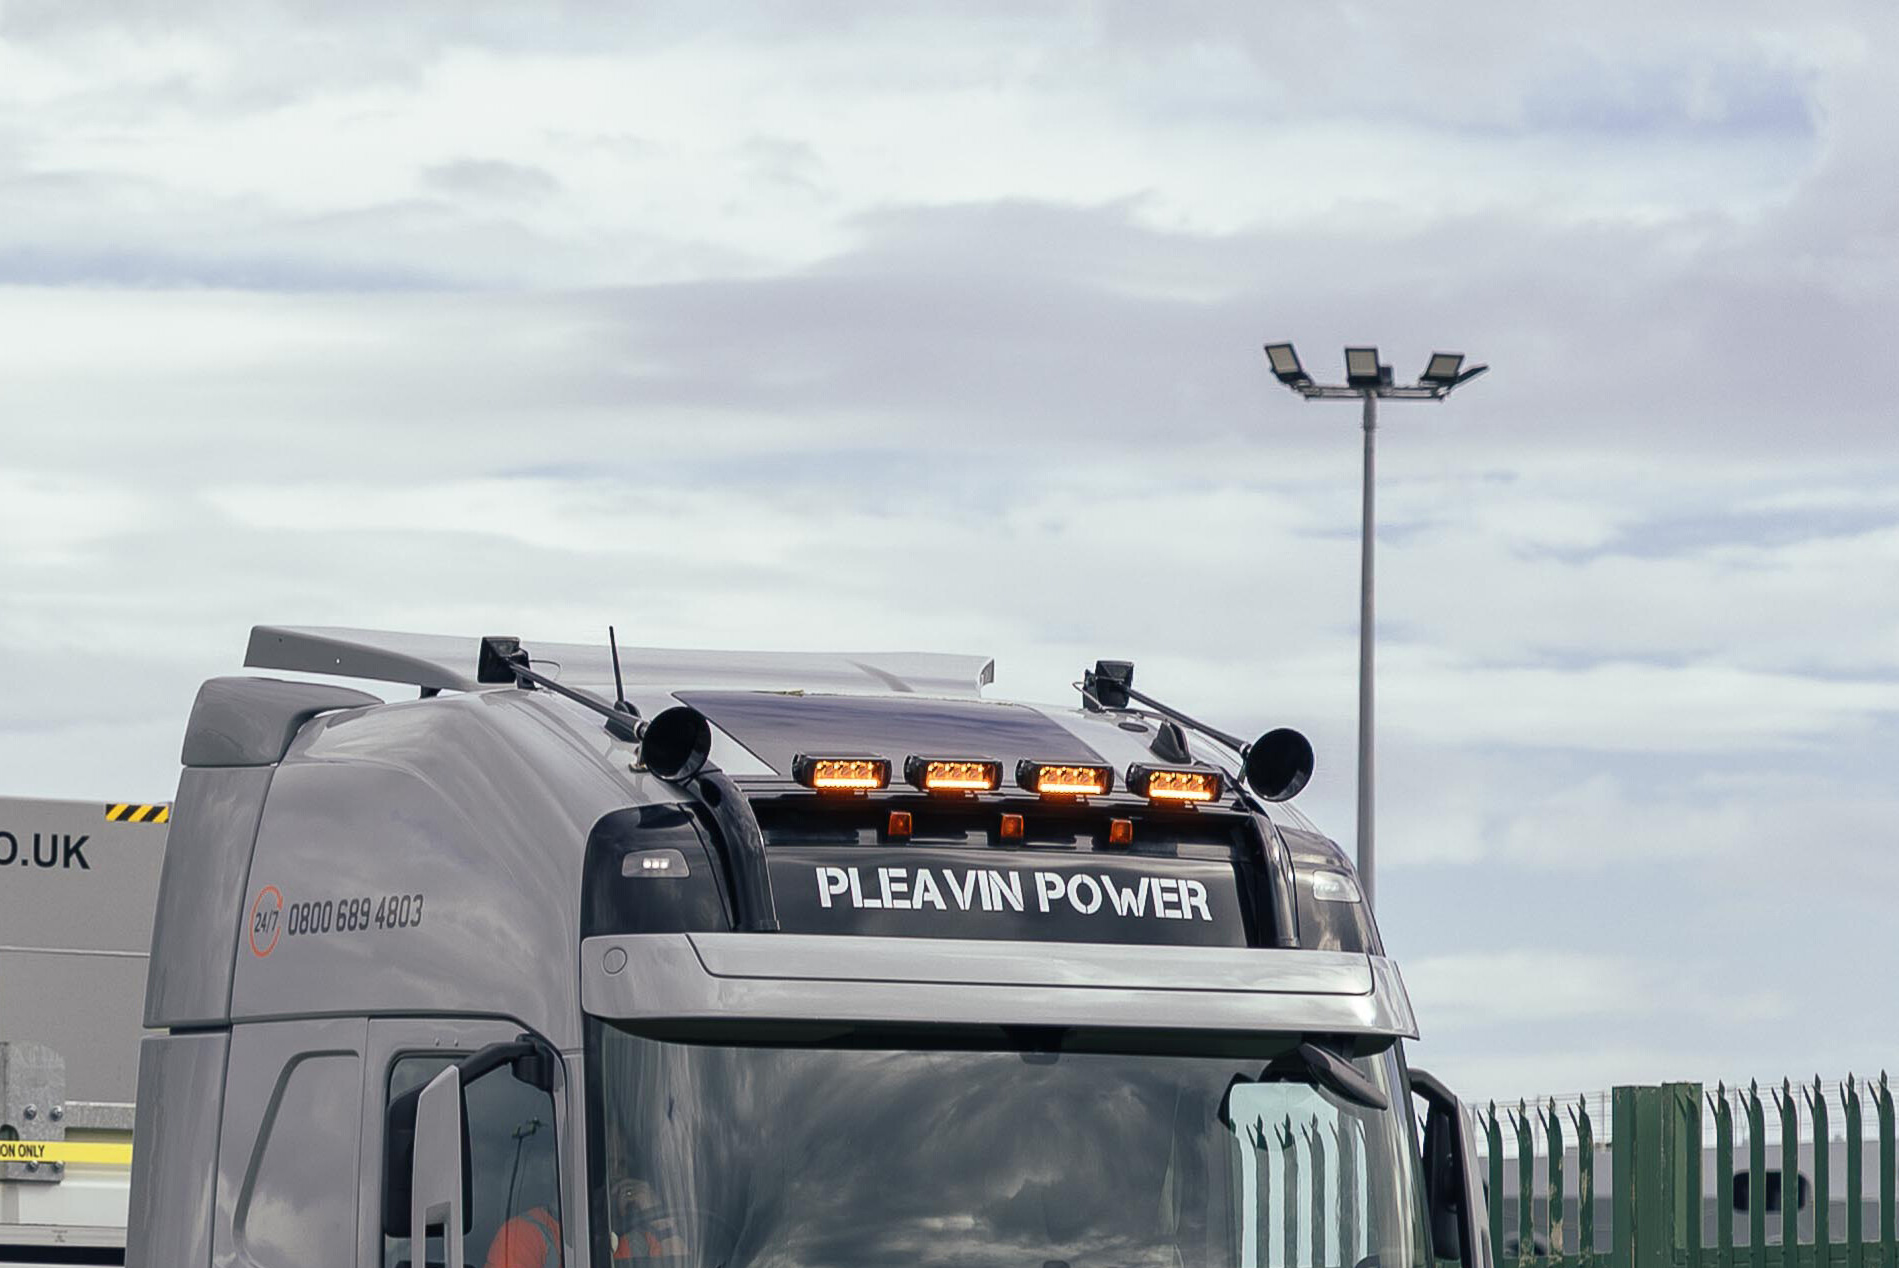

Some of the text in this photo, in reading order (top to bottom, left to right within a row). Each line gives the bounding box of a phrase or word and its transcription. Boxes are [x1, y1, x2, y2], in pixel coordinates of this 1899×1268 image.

[254, 894, 424, 936] 24/7 0800 689 4803
[816, 867, 1213, 921] PLEAVIN POWER
[18, 1143, 45, 1159] ONLY
